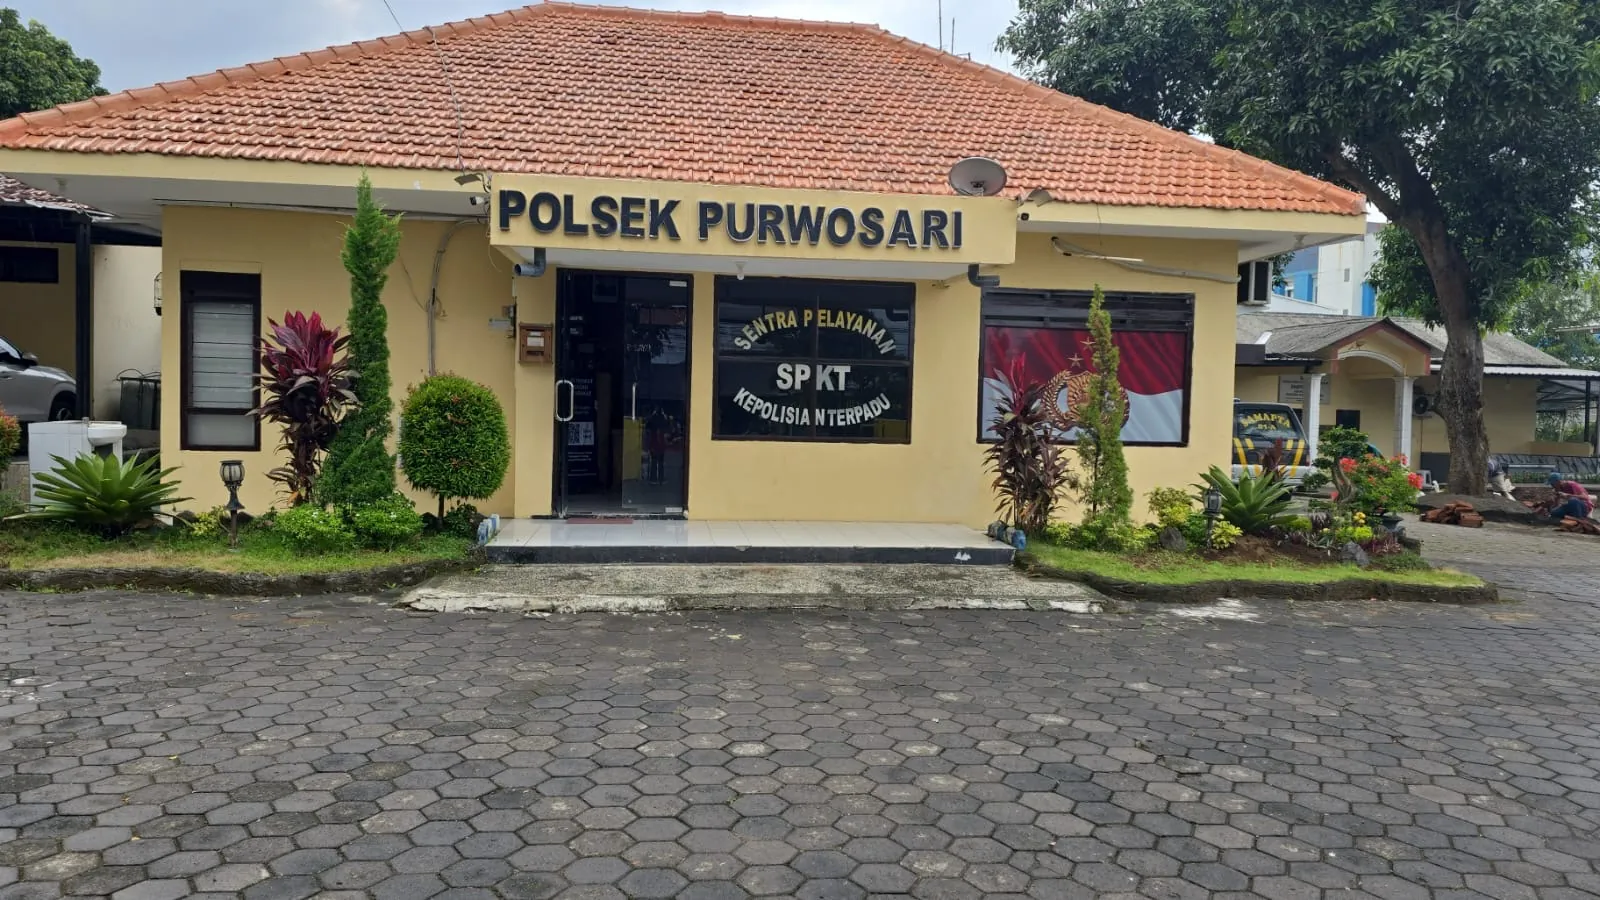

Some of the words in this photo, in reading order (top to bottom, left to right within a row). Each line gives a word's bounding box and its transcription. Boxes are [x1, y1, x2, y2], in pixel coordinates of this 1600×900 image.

[499, 189, 681, 241] POLSEK
[697, 200, 963, 249] PURWOSARI
[734, 310, 798, 350] SENTRA
[803, 309, 897, 355] PELAYANAN
[776, 363, 851, 391] SPKT
[827, 393, 891, 427] TERPADU
[1240, 412, 1291, 429] SAMAPTA
